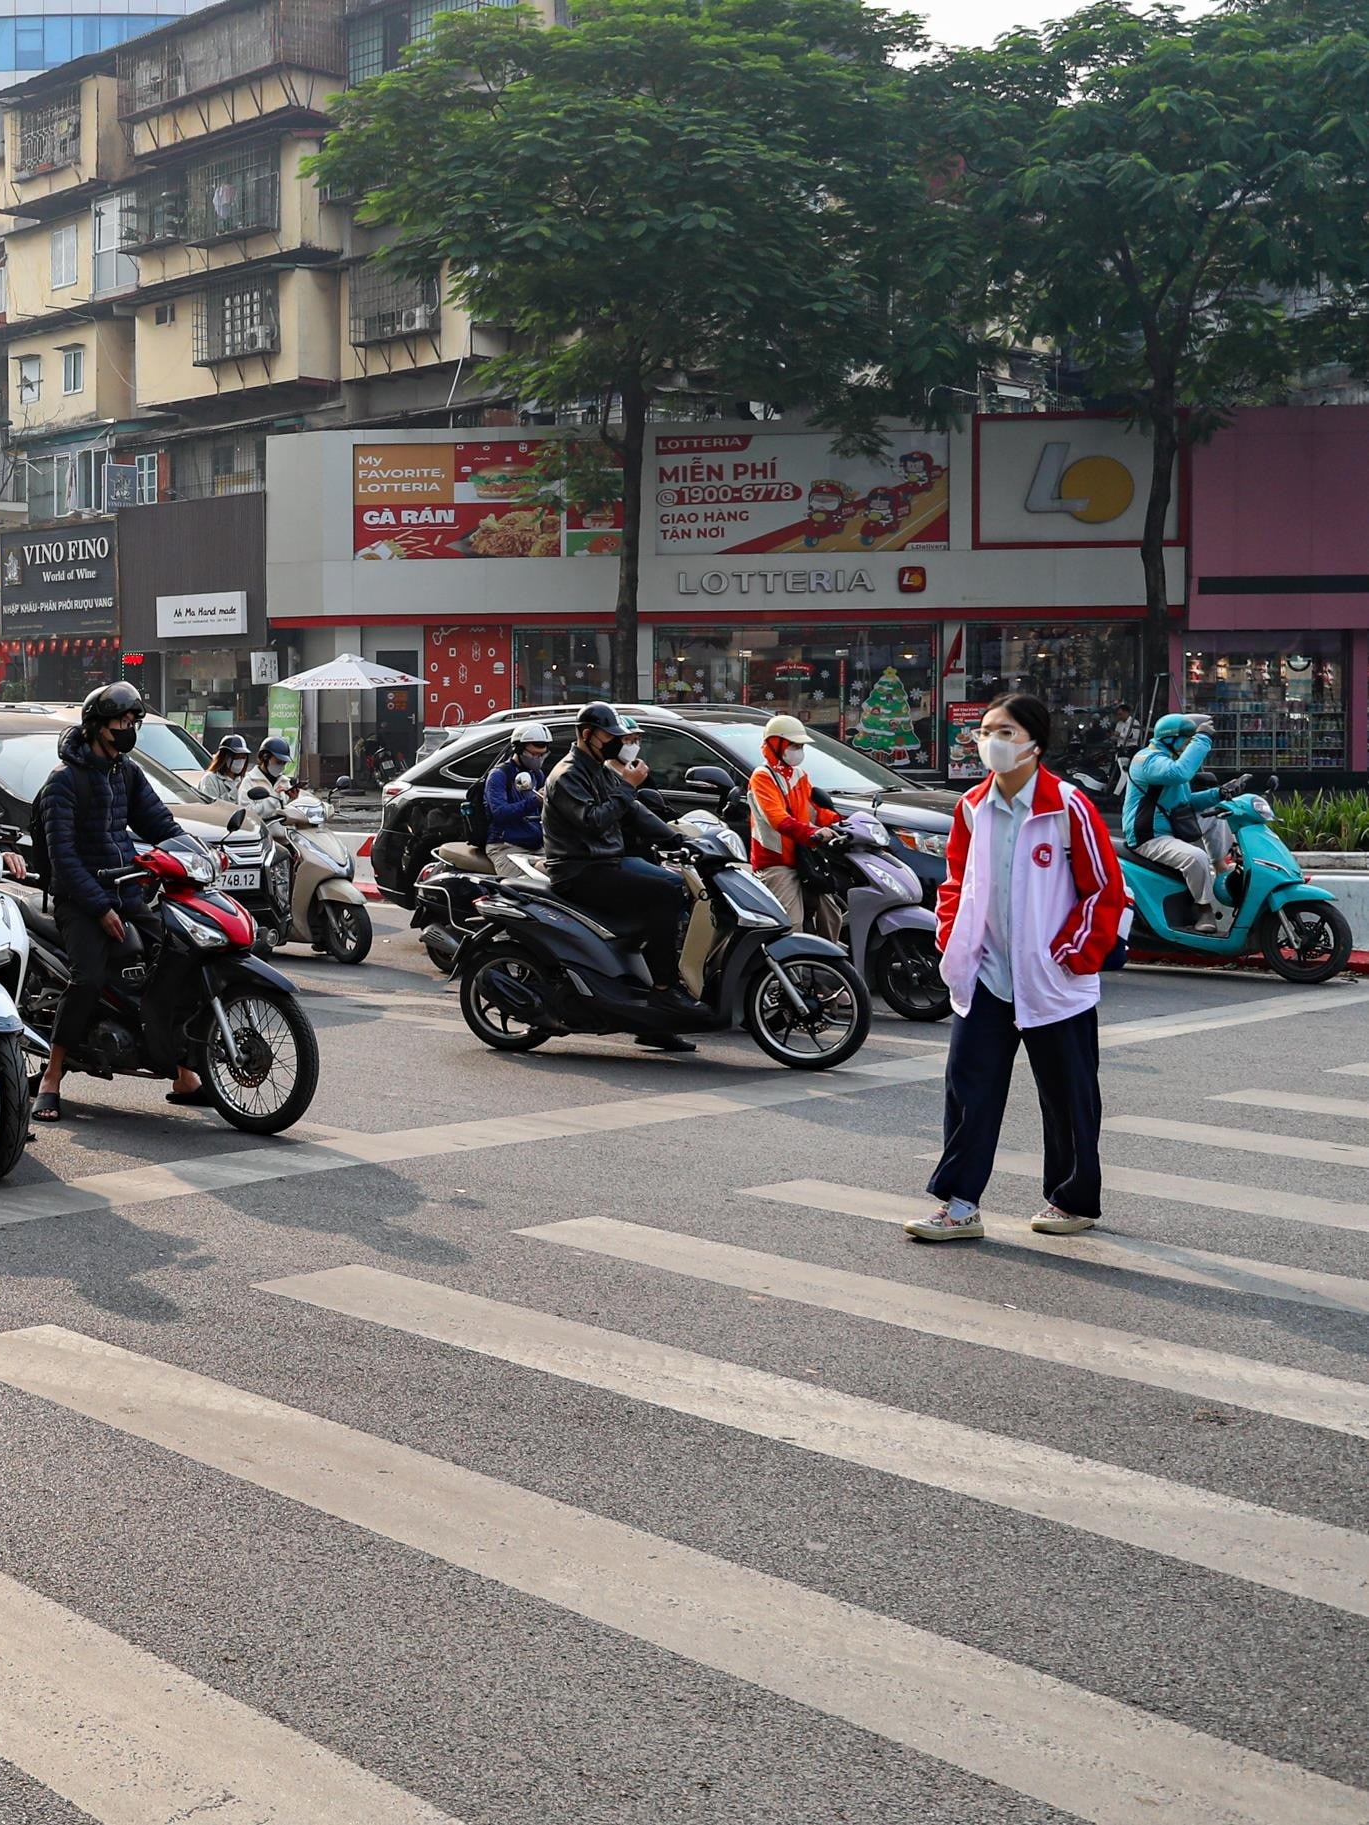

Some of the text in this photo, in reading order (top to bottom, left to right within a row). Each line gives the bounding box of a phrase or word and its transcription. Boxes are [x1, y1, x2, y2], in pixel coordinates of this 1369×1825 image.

[658, 437, 742, 450] LOTTERIA
[358, 455, 383, 467] My
[358, 468, 445, 479] FAVORITE,
[659, 457, 778, 483] MIỄN PHÍ
[358, 482, 441, 493] LOTTERIA
[681, 483, 795, 503] 1900-6778
[363, 507, 455, 525] GÀ RÁN
[660, 509, 750, 525] GIAO HÀNG
[660, 527, 725, 542] TẬN NƠI
[23, 542, 64, 566] VINO
[67, 537, 109, 561] FINO
[42, 567, 97, 583] World of Wine
[678, 569, 876, 596] LOTTERIA
[2, 602, 20, 616] NHẬP
[58, 598, 73, 611] PHỐI
[74, 598, 93, 611] RƯỢU
[94, 597, 113, 608] VANG
[185, 607, 196, 617] Ma
[198, 606, 217, 616] Hand
[218, 605, 237, 615] made
